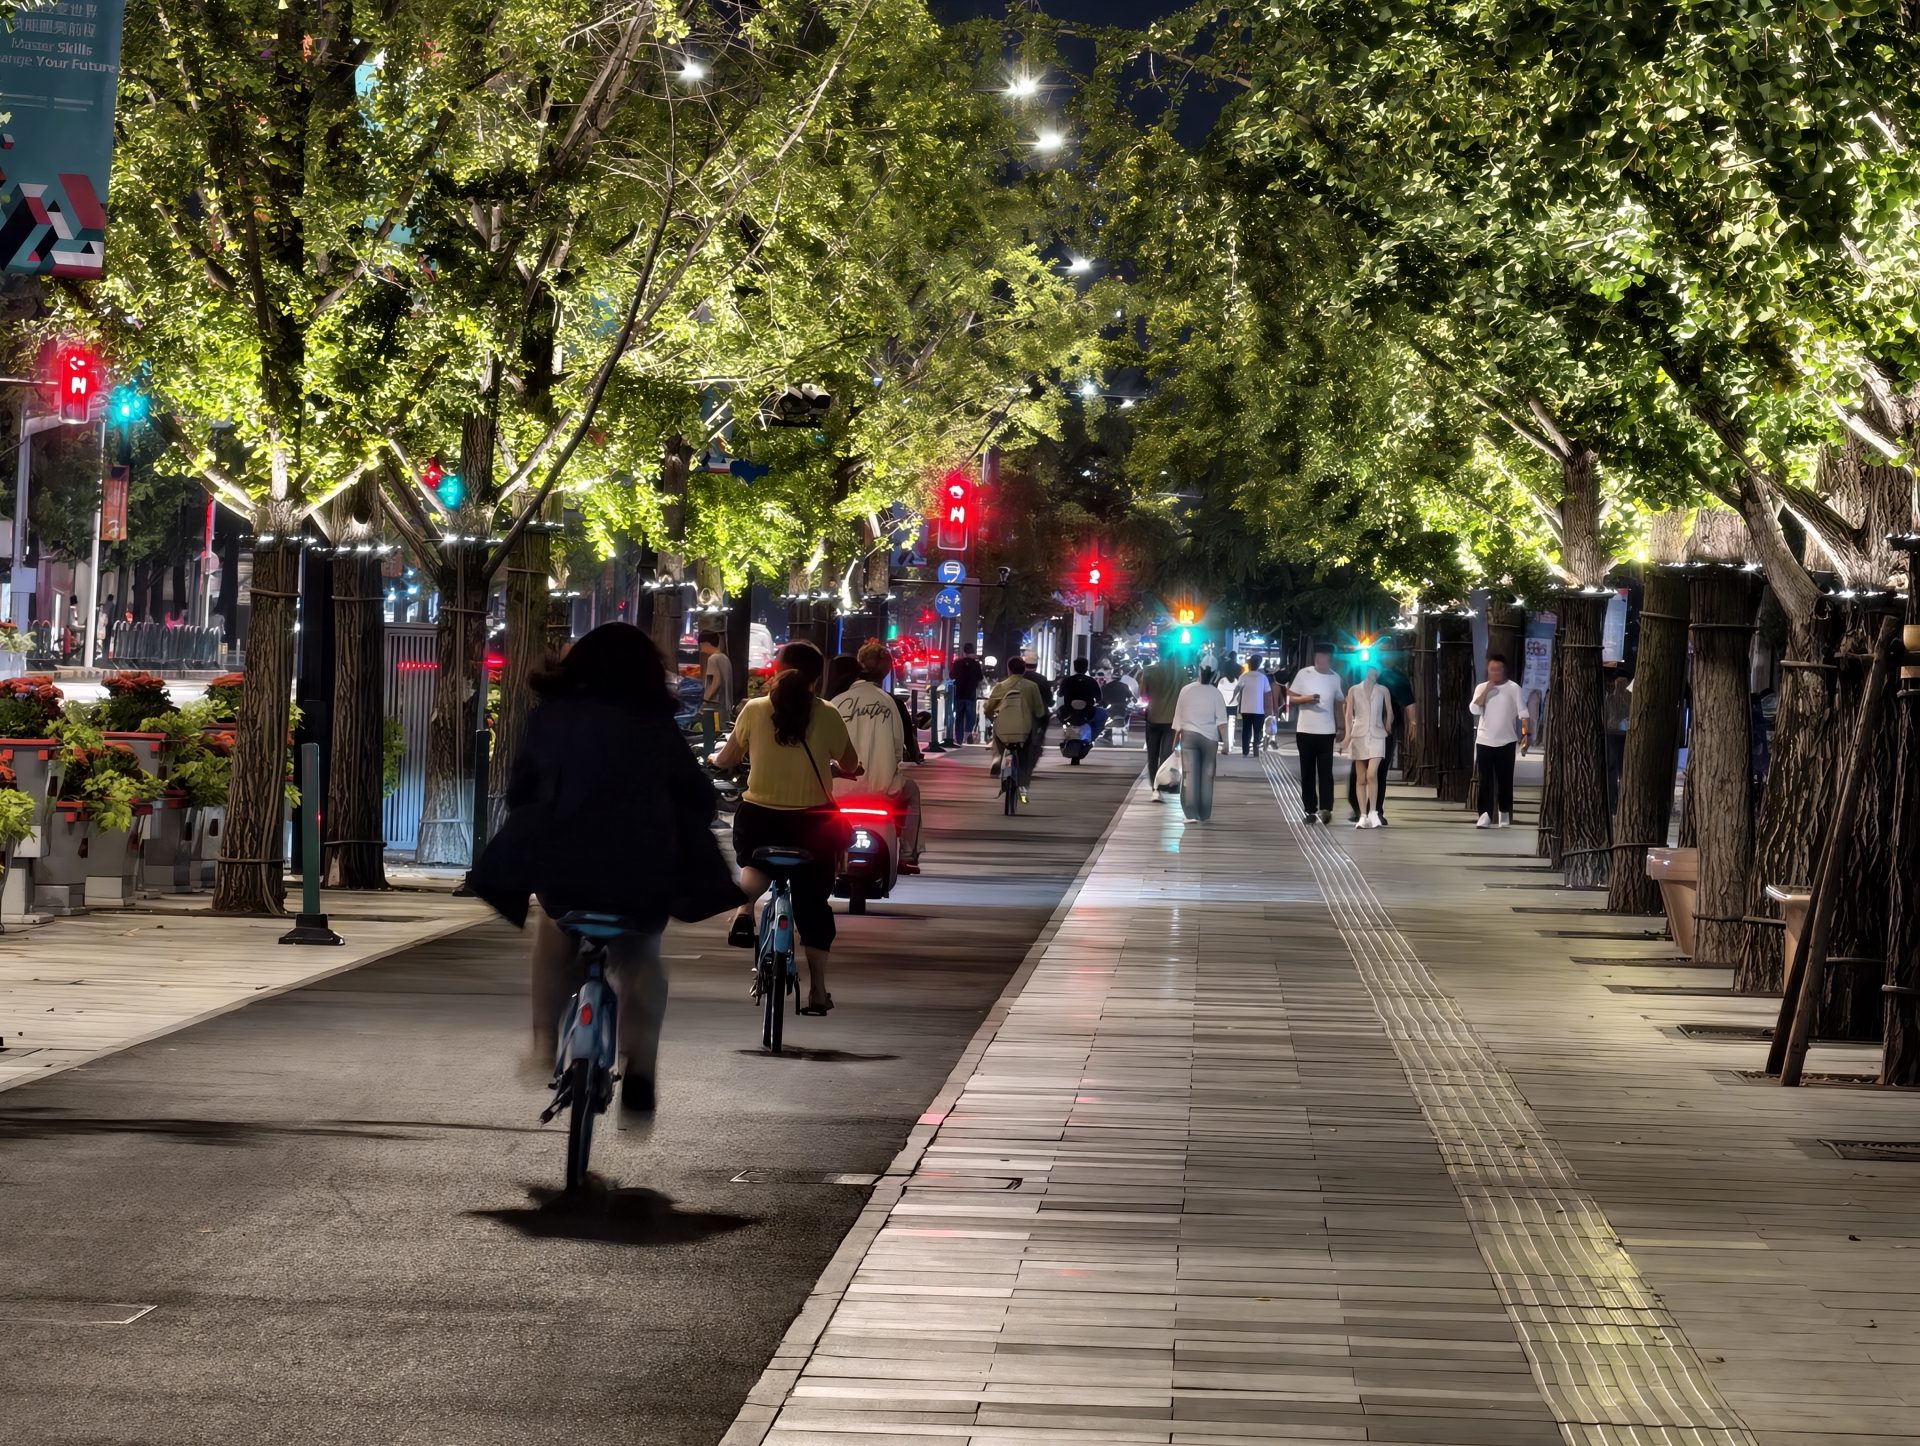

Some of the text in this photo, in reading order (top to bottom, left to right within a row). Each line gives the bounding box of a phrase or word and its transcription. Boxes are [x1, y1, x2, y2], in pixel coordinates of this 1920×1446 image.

[12, 38, 93, 56] Master Skills
[36, 56, 69, 69] Your
[72, 59, 117, 73] Future
